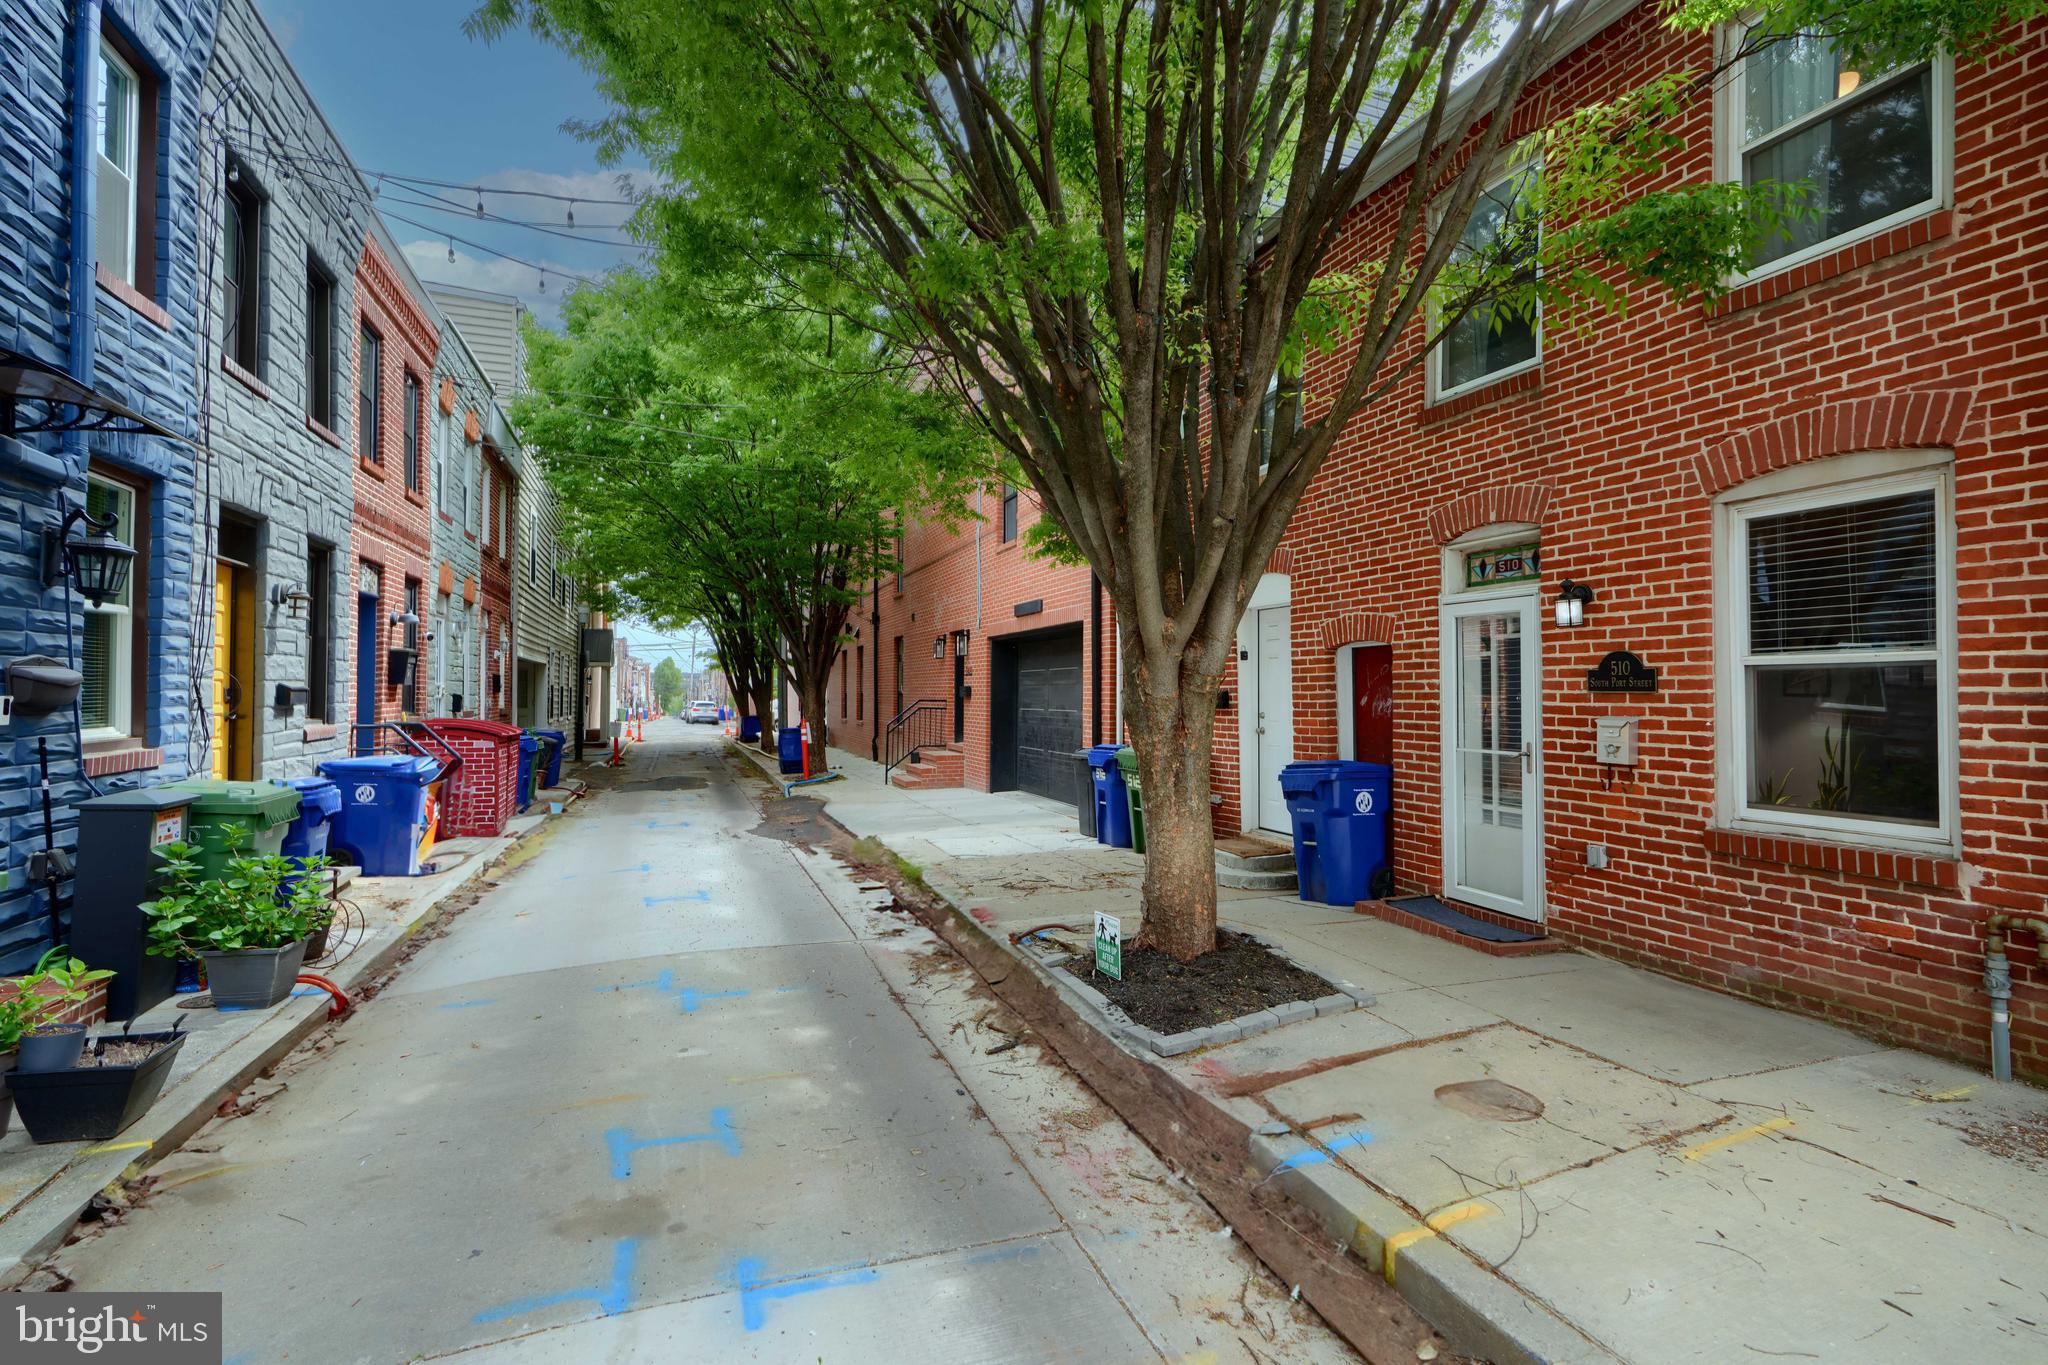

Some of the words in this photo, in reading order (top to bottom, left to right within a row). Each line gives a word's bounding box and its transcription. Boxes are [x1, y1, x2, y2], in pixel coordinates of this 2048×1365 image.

[1498, 559, 1519, 571] 510
[1611, 660, 1630, 676] 510
[1102, 952, 1114, 963] AFTER
